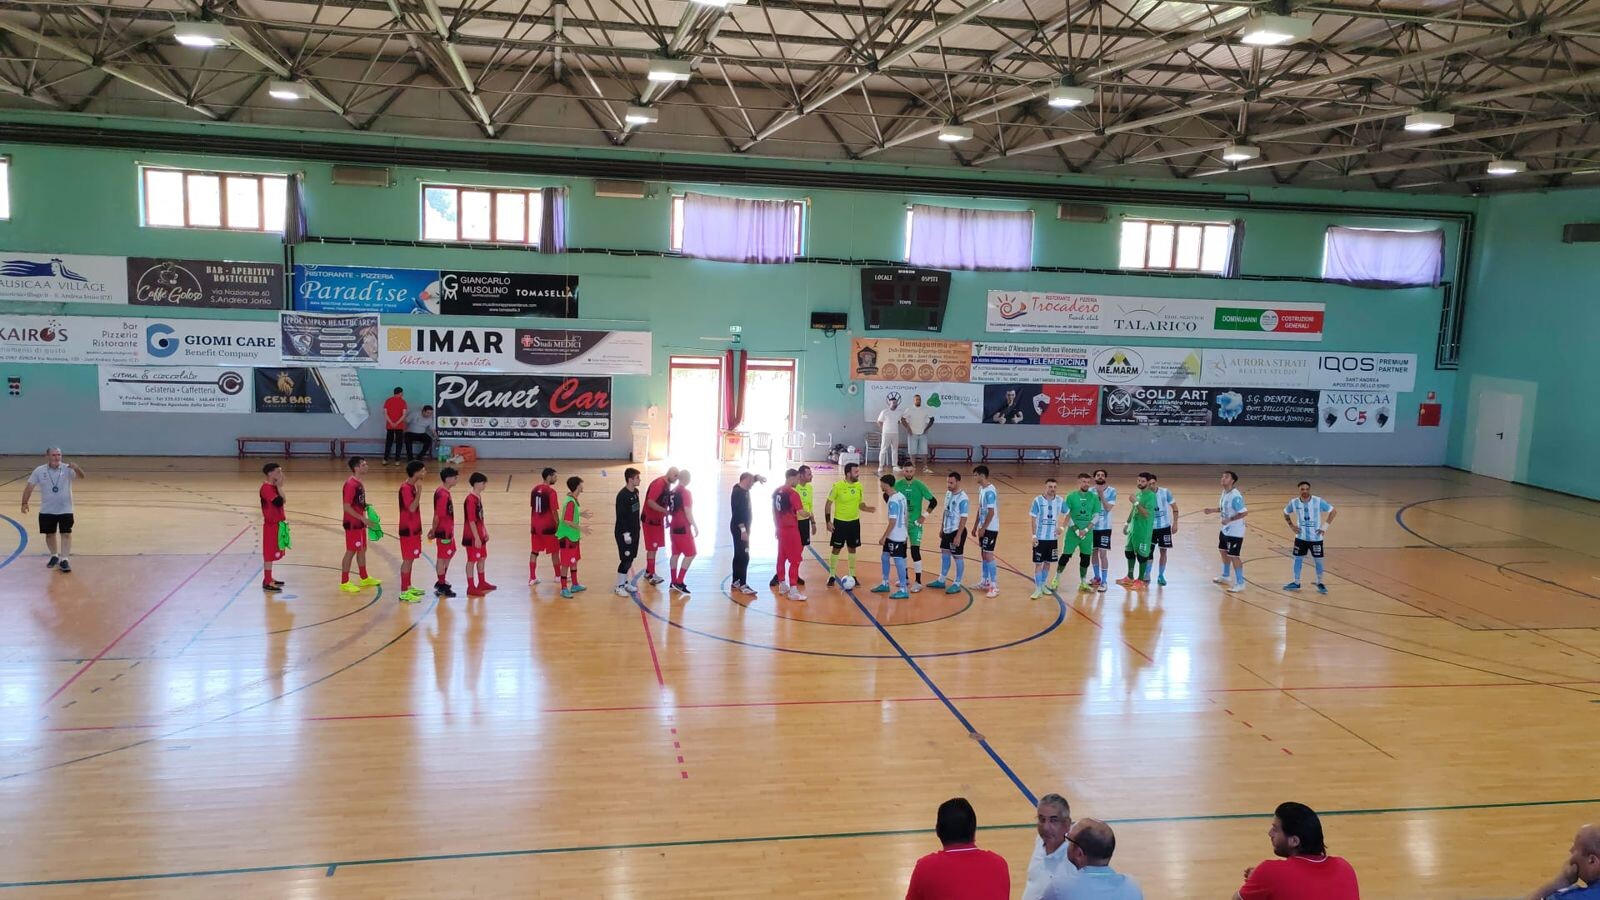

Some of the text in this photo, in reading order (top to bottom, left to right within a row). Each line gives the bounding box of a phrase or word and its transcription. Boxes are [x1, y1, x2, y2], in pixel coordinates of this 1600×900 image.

[232, 267, 275, 275] APERITIVI
[214, 274, 268, 283] ROSTICCERIA
[460, 276, 510, 285] GIANCARLO
[59, 282, 106, 292] VILLAGE
[300, 280, 407, 301] Paradise
[462, 286, 508, 294] MUSOLINO
[168, 287, 203, 304] Goloso
[1032, 297, 1099, 313] Trocadero
[1114, 320, 1197, 331] TALARICO
[185, 335, 276, 347] GIOMI CARE
[417, 329, 503, 354] IMAR
[219, 350, 259, 359] Company
[1273, 359, 1307, 367] STRATI
[1319, 356, 1374, 372] IQOS
[1098, 366, 1139, 374] ME.MARM
[437, 376, 608, 413] Planet Car
[1136, 390, 1208, 400] GOLD ART
[1326, 394, 1390, 404] NAUSICAA
[1345, 407, 1367, 425] C5
[536, 496, 542, 512] 11
[775, 494, 782, 511] 6
